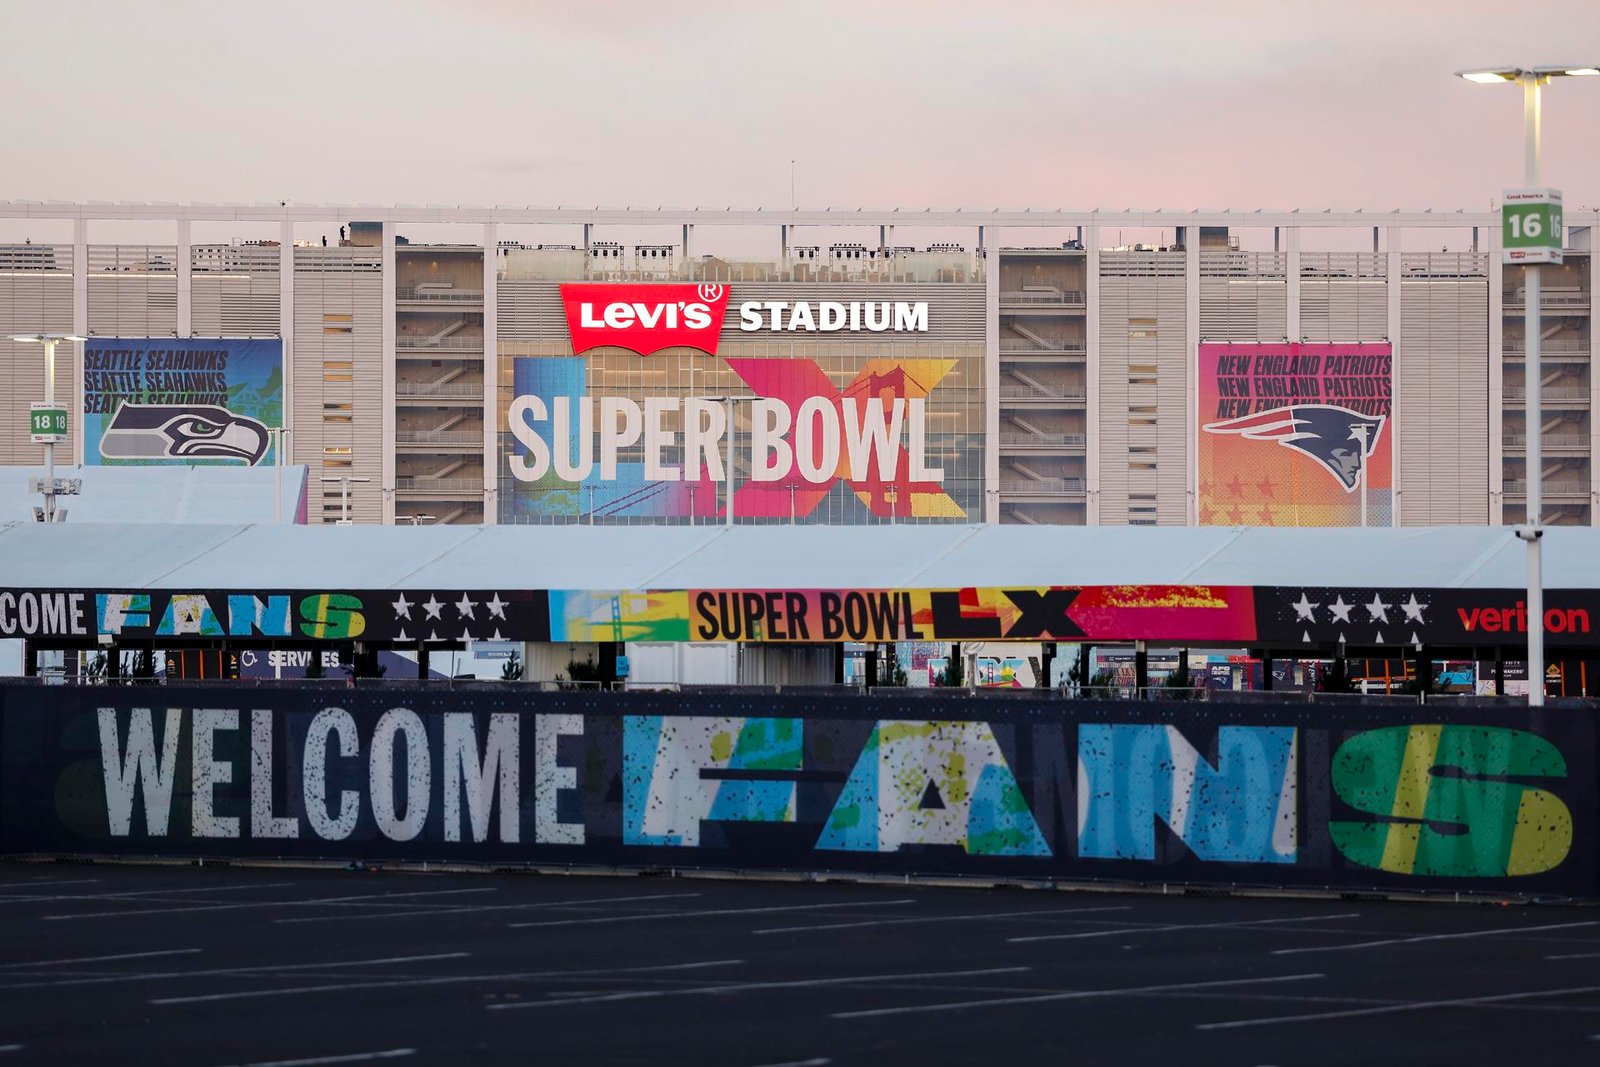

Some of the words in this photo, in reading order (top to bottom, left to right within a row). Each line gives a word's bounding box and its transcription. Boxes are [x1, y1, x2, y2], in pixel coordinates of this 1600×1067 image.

[1509, 213, 1542, 238] 16
[1550, 214, 1561, 238] 16
[740, 301, 928, 331] STADIUM
[84, 350, 142, 370] SEATTLE
[146, 350, 229, 370] SEAHAWKS
[1217, 355, 1251, 376] NEW
[1254, 355, 1321, 376] ENGLAND
[1323, 355, 1392, 376] PATRIOTS
[84, 372, 143, 392] SEATTLE
[145, 372, 228, 392] SEAHAWKS
[1217, 377, 1250, 397] NEW
[1254, 377, 1321, 397] ENGLAND
[1323, 377, 1392, 397] PATRIOTS
[1217, 399, 1251, 418] NEW
[34, 415, 51, 429] 18
[56, 415, 66, 429] 18
[508, 395, 727, 483] SUPER
[751, 395, 945, 484] BOWL
[95, 593, 366, 639] FANS
[696, 592, 810, 640] SUPER
[820, 592, 924, 640] BOWL
[930, 588, 1088, 639] LX
[1457, 601, 1590, 633] verion
[268, 651, 340, 667] SERVIES
[97, 707, 586, 845] WELCOME
[623, 713, 1573, 878] FANS
